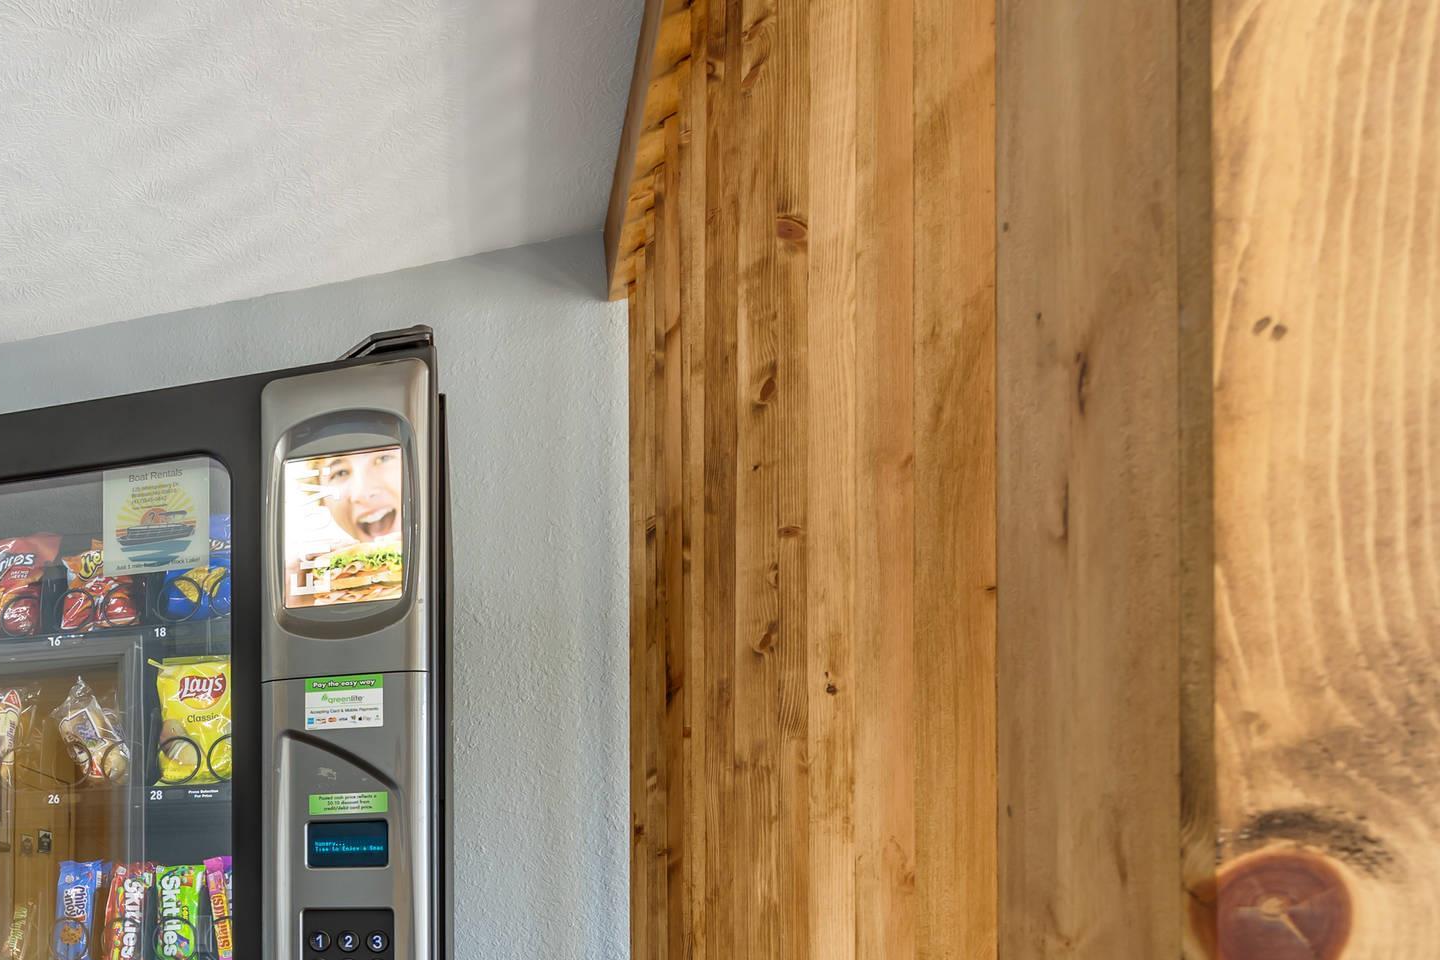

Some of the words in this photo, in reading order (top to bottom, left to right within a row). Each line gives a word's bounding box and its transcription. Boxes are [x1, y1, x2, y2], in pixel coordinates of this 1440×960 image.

[128, 473, 148, 483] Boat
[150, 468, 183, 480] Rentals
[154, 627, 166, 638] 18
[180, 676, 224, 700] Lay's
[313, 681, 327, 689] Pay
[341, 680, 357, 688] easy
[359, 679, 375, 687] way
[48, 794, 60, 804] 26
[150, 790, 163, 801] 28
[73, 884, 87, 918] Chips
[121, 878, 144, 958] Skittles
[161, 875, 181, 957] Skittles
[316, 934, 323, 948] 1
[344, 935, 353, 948] 2
[372, 935, 383, 949] 3
